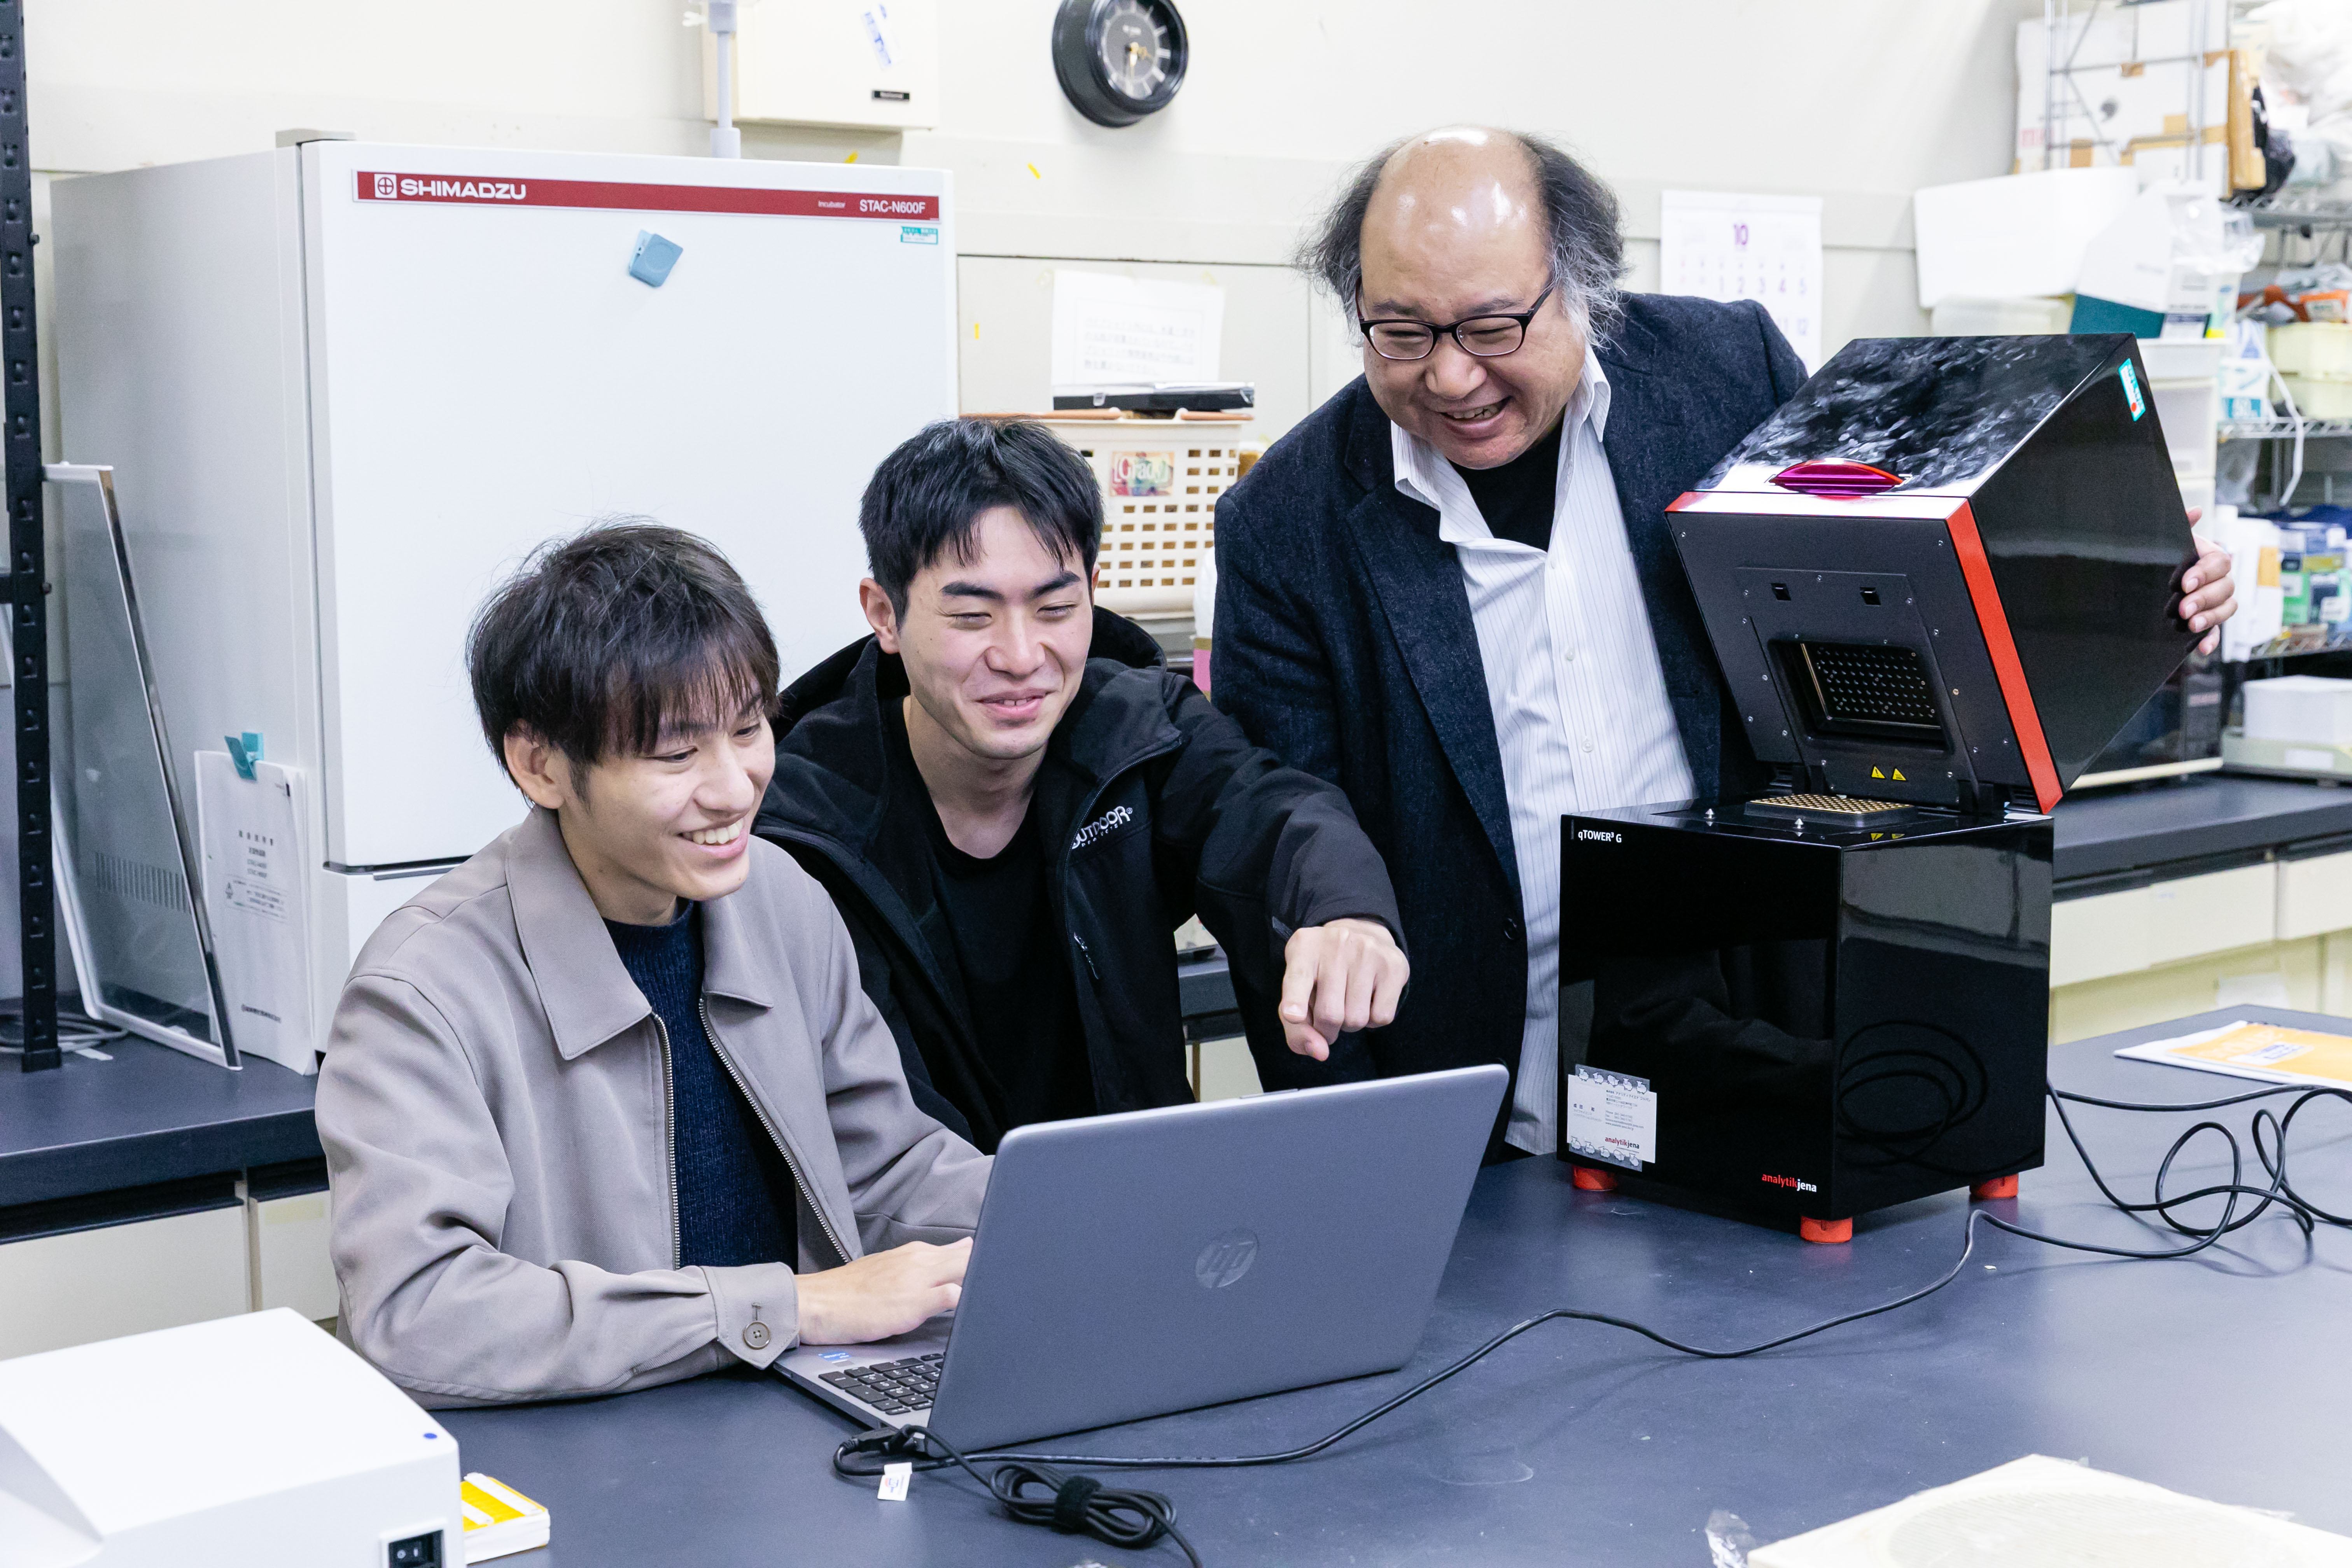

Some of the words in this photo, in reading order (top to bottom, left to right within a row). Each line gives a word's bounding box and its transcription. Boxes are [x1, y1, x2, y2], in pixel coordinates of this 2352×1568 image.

[400, 178, 526, 200] SHIMADZU
[859, 199, 926, 214] STAC-N600F
[1732, 222, 1749, 246] 10
[1615, 833, 1622, 843] G
